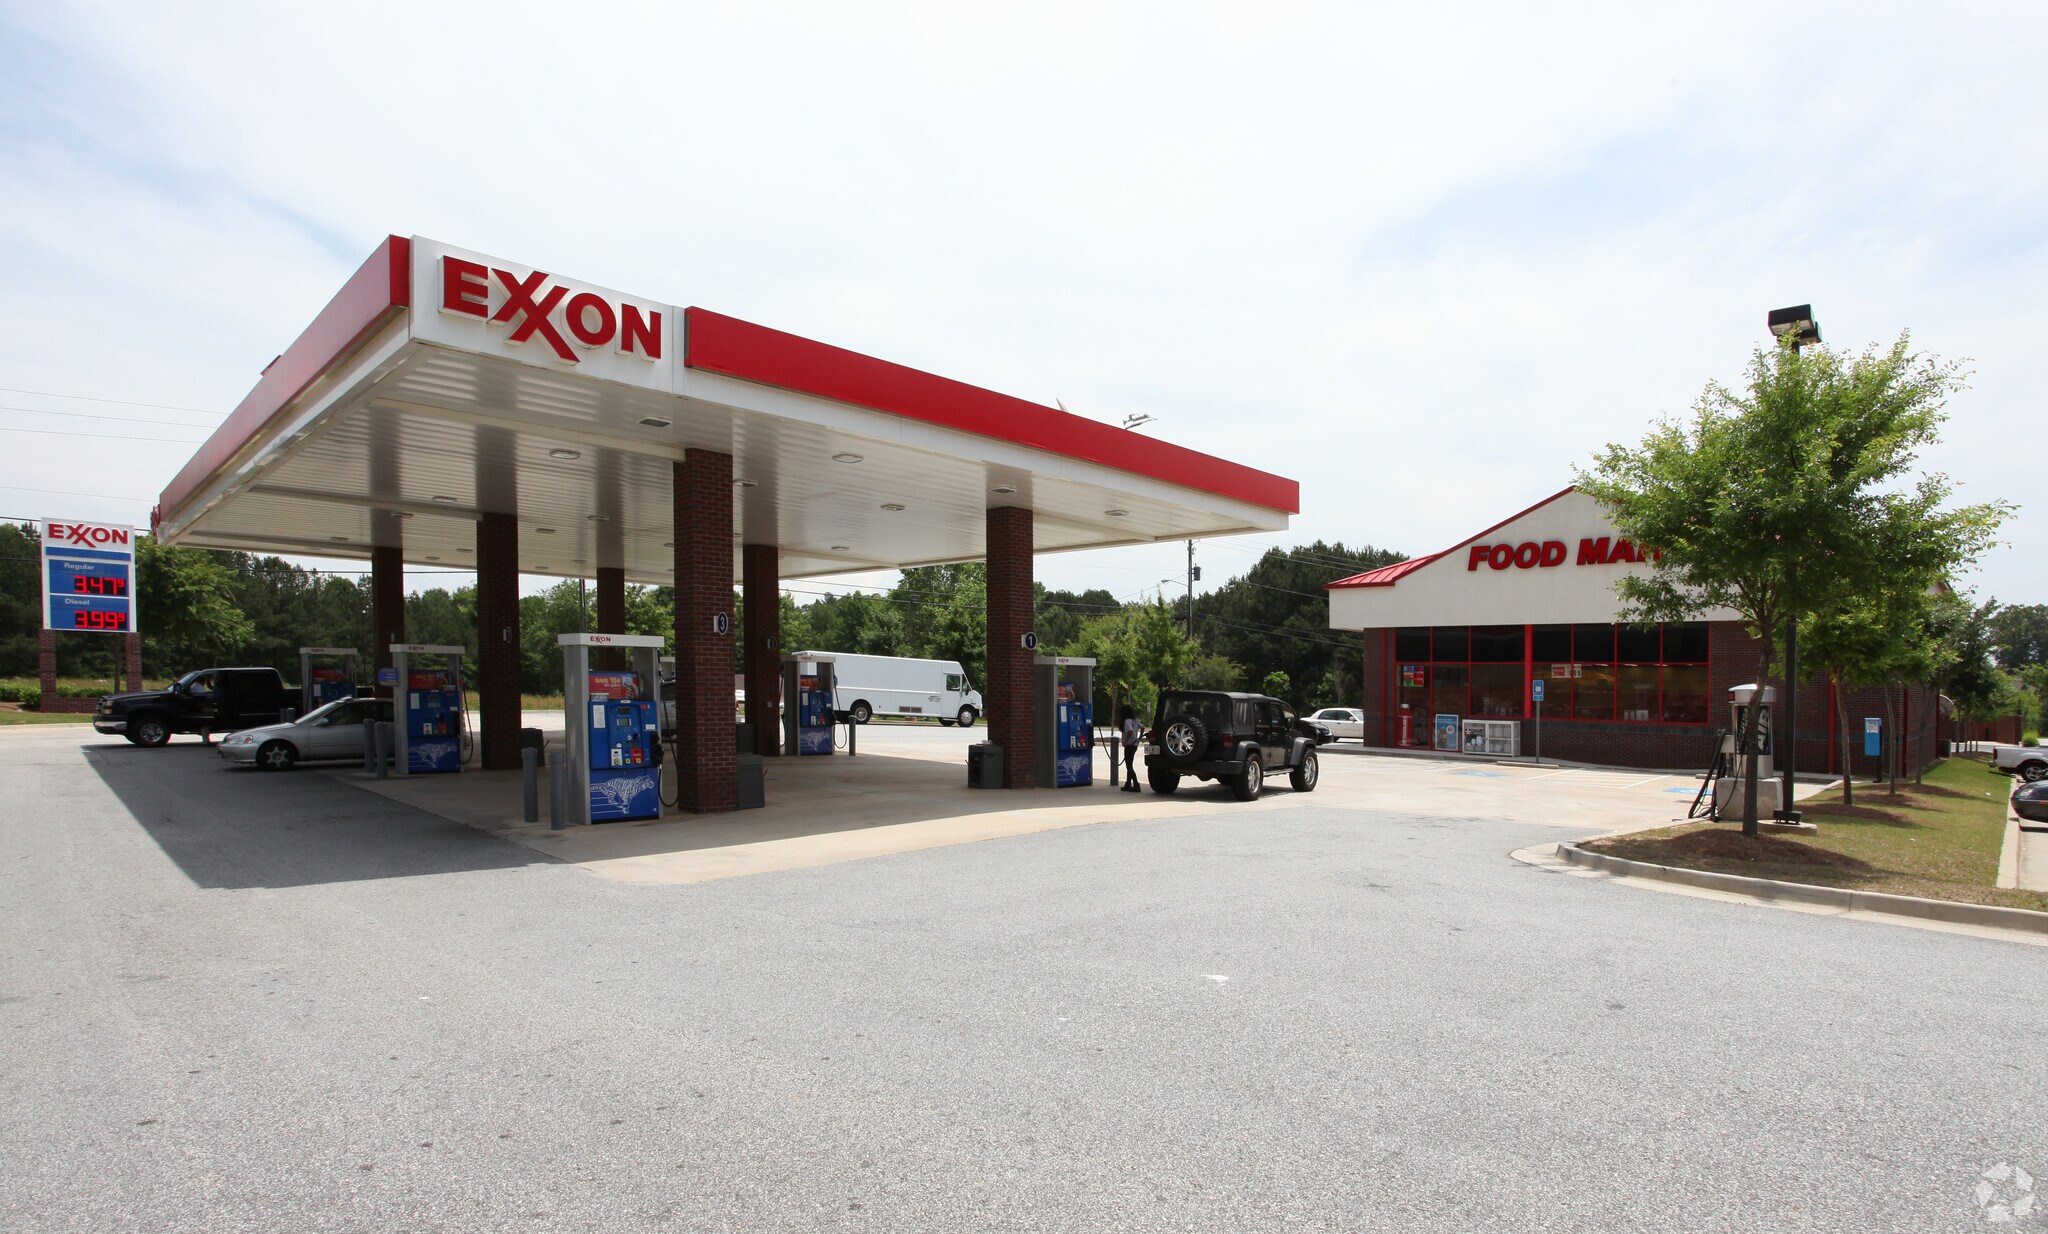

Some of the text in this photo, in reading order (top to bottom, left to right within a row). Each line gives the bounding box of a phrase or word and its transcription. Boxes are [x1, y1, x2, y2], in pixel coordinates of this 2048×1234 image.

[440, 255, 662, 363] EXXON
[48, 523, 128, 548] EXXON
[1468, 536, 1662, 571] FOOD MA
[64, 562, 95, 571] Regular
[65, 598, 89, 606] Diesel
[720, 617, 726, 631] 3
[590, 635, 611, 644] EXXON
